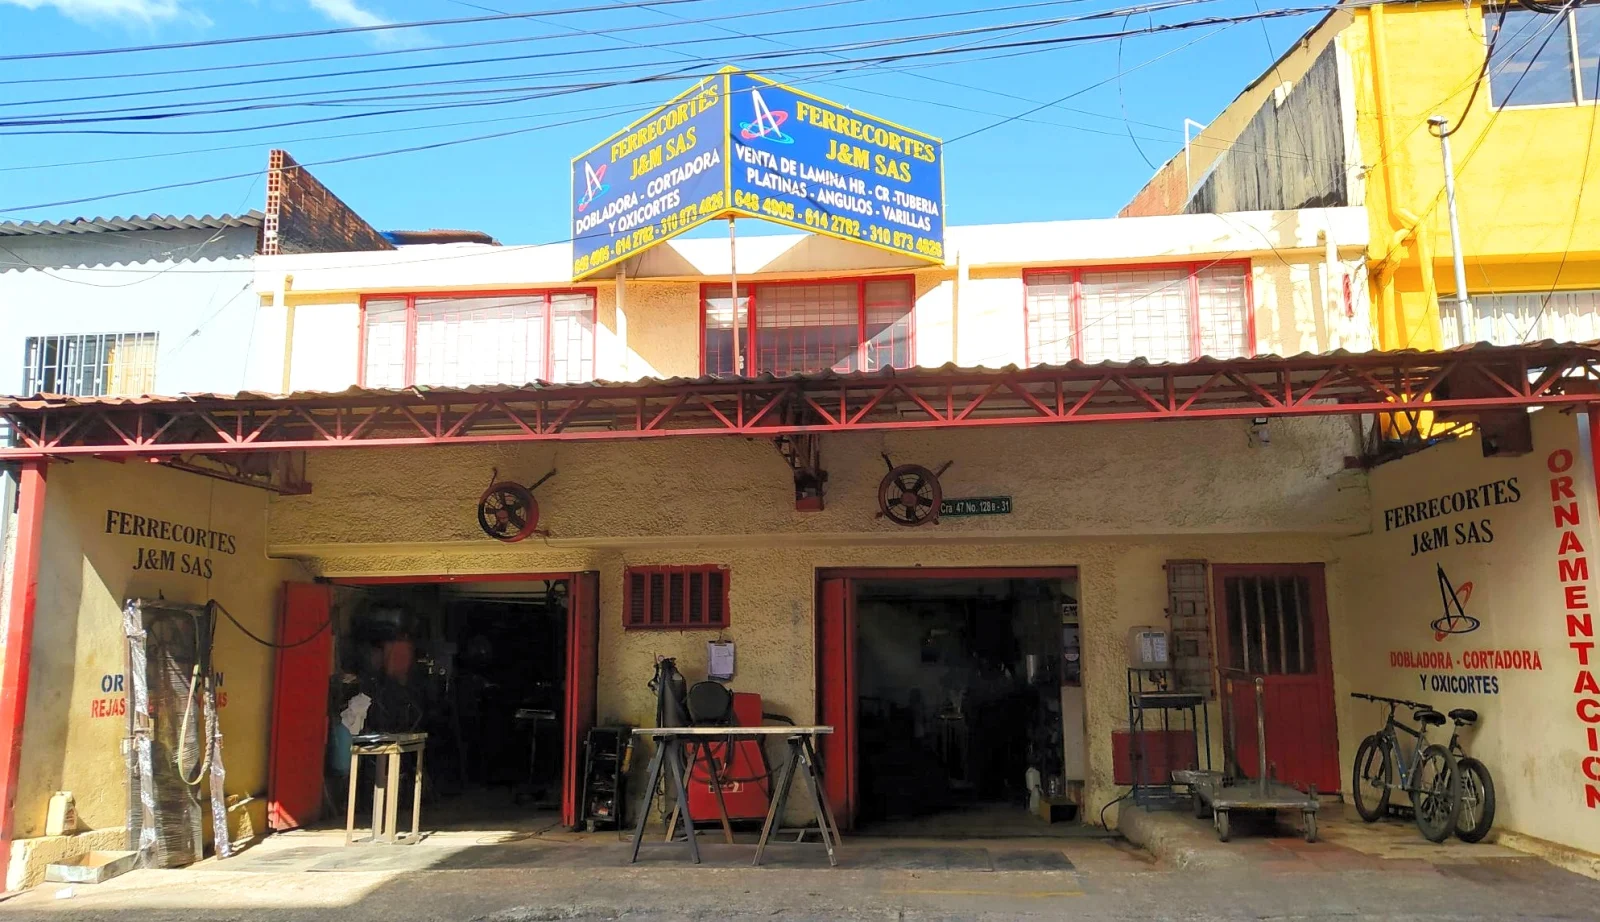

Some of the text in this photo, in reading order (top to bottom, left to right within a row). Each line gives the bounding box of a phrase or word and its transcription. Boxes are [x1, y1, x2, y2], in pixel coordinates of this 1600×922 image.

[611, 84, 719, 163] FERRECORTES
[796, 100, 936, 163] FERRECORTES
[630, 126, 697, 180] J&M SAS
[735, 143, 778, 171] VENTA
[780, 157, 797, 176] DE
[800, 163, 847, 190] LAMINA
[849, 177, 866, 195] HR
[875, 184, 890, 202] CR
[826, 139, 911, 183] J&M SAS
[576, 192, 638, 235] DOBLADORA
[647, 148, 720, 198] CORTADORA
[608, 189, 680, 237] Y OXICORTES
[747, 166, 807, 198] PLATINAS
[817, 187, 873, 216] ANGULOS
[882, 204, 931, 232] VARILLAS
[805, 208, 828, 229] 614
[870, 224, 891, 244] 310
[941, 503, 953, 513] Cra
[956, 502, 964, 512] 47
[1001, 501, 1009, 511] 31
[1384, 477, 1521, 531] FERRECORTES
[105, 509, 236, 555] FERRECORTES
[1411, 519, 1494, 556] J&M SAS
[132, 547, 213, 579] J&M SAS
[1390, 651, 1453, 669] DOBLADORA
[1463, 650, 1542, 670] CORTADORA
[1420, 674, 1499, 694] Y OXICORTES
[91, 698, 126, 718] REJAS
